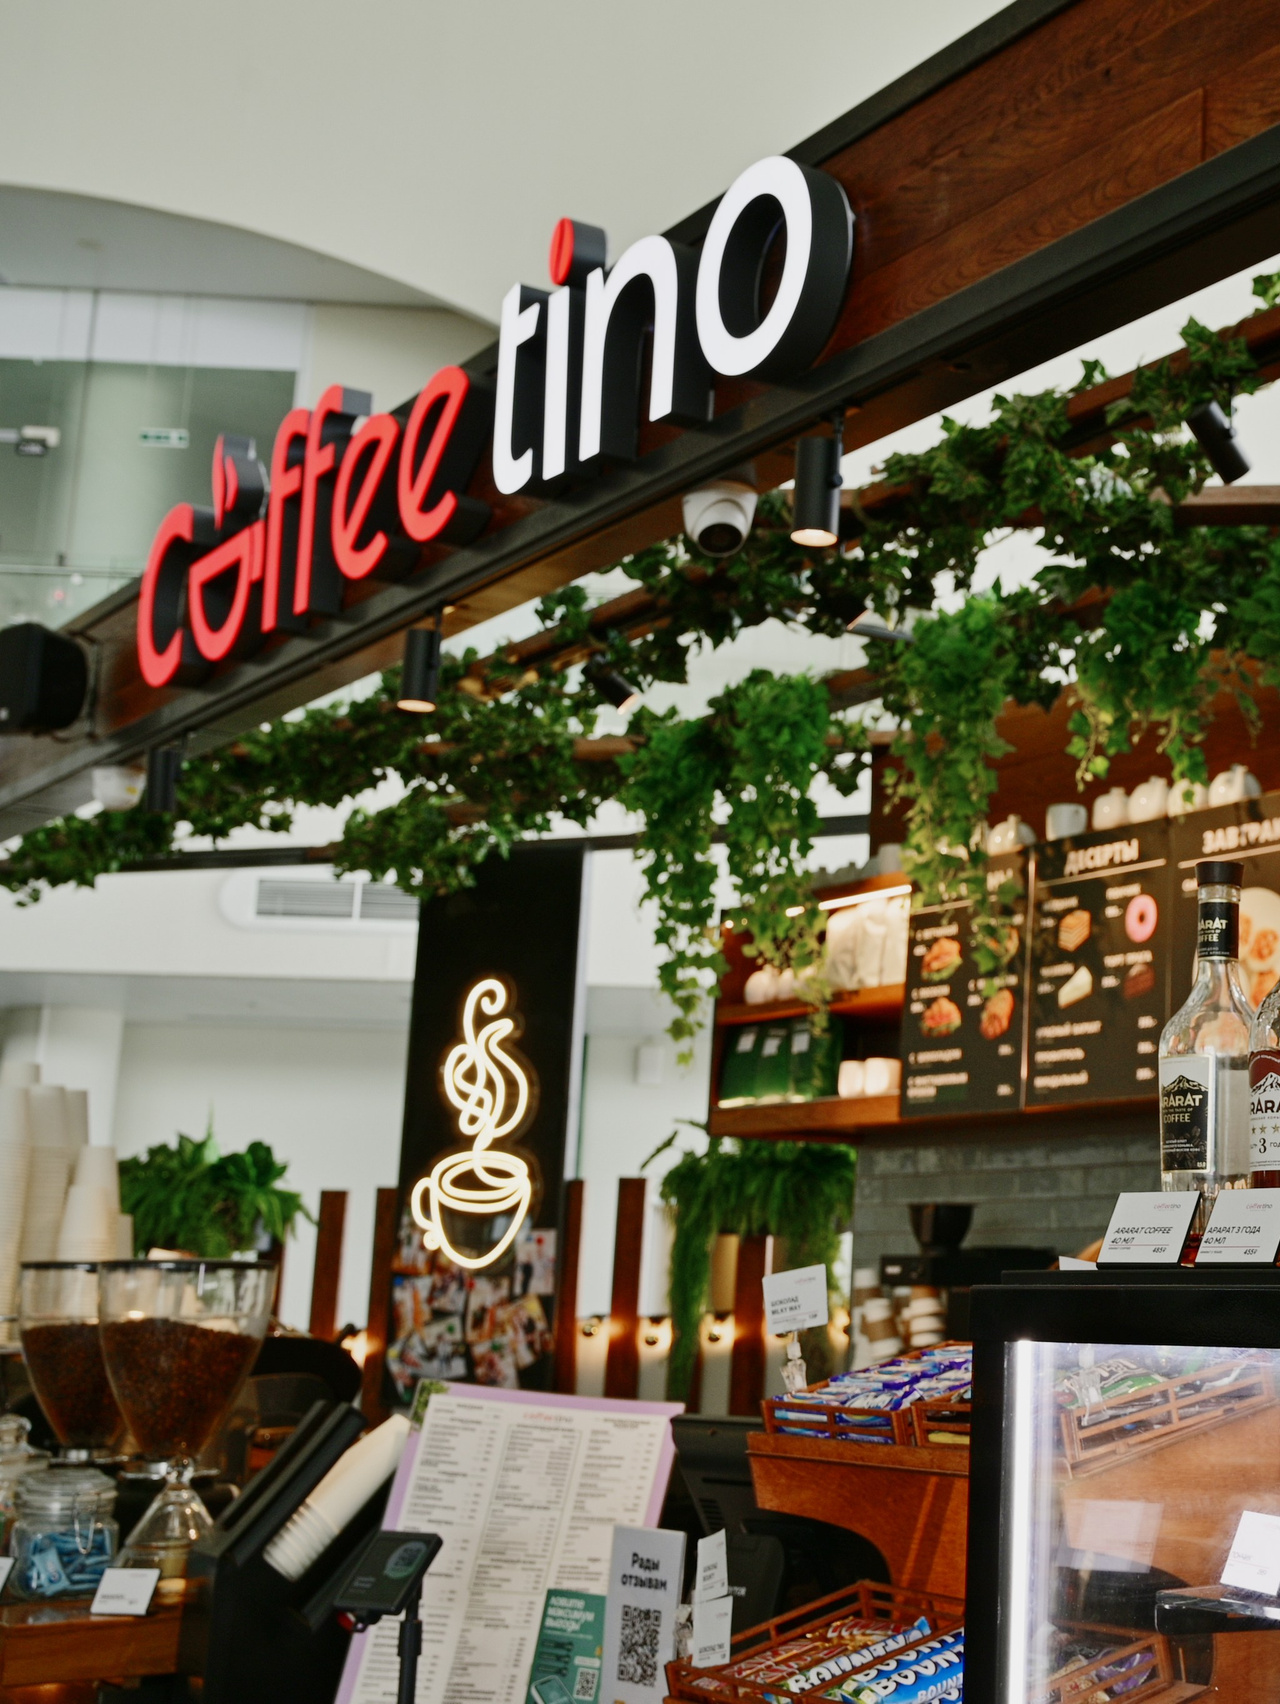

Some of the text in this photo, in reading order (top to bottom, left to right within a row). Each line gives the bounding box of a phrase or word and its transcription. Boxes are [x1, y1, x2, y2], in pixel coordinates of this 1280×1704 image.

[1162, 1092, 1203, 1108] RARAT
[1164, 1113, 1191, 1123] COFFEE
[1259, 1138, 1267, 1153] 3
[1240, 1226, 1261, 1234] ГОДА
[631, 1551, 660, 1572] Рады
[621, 1572, 667, 1591] отзывам
